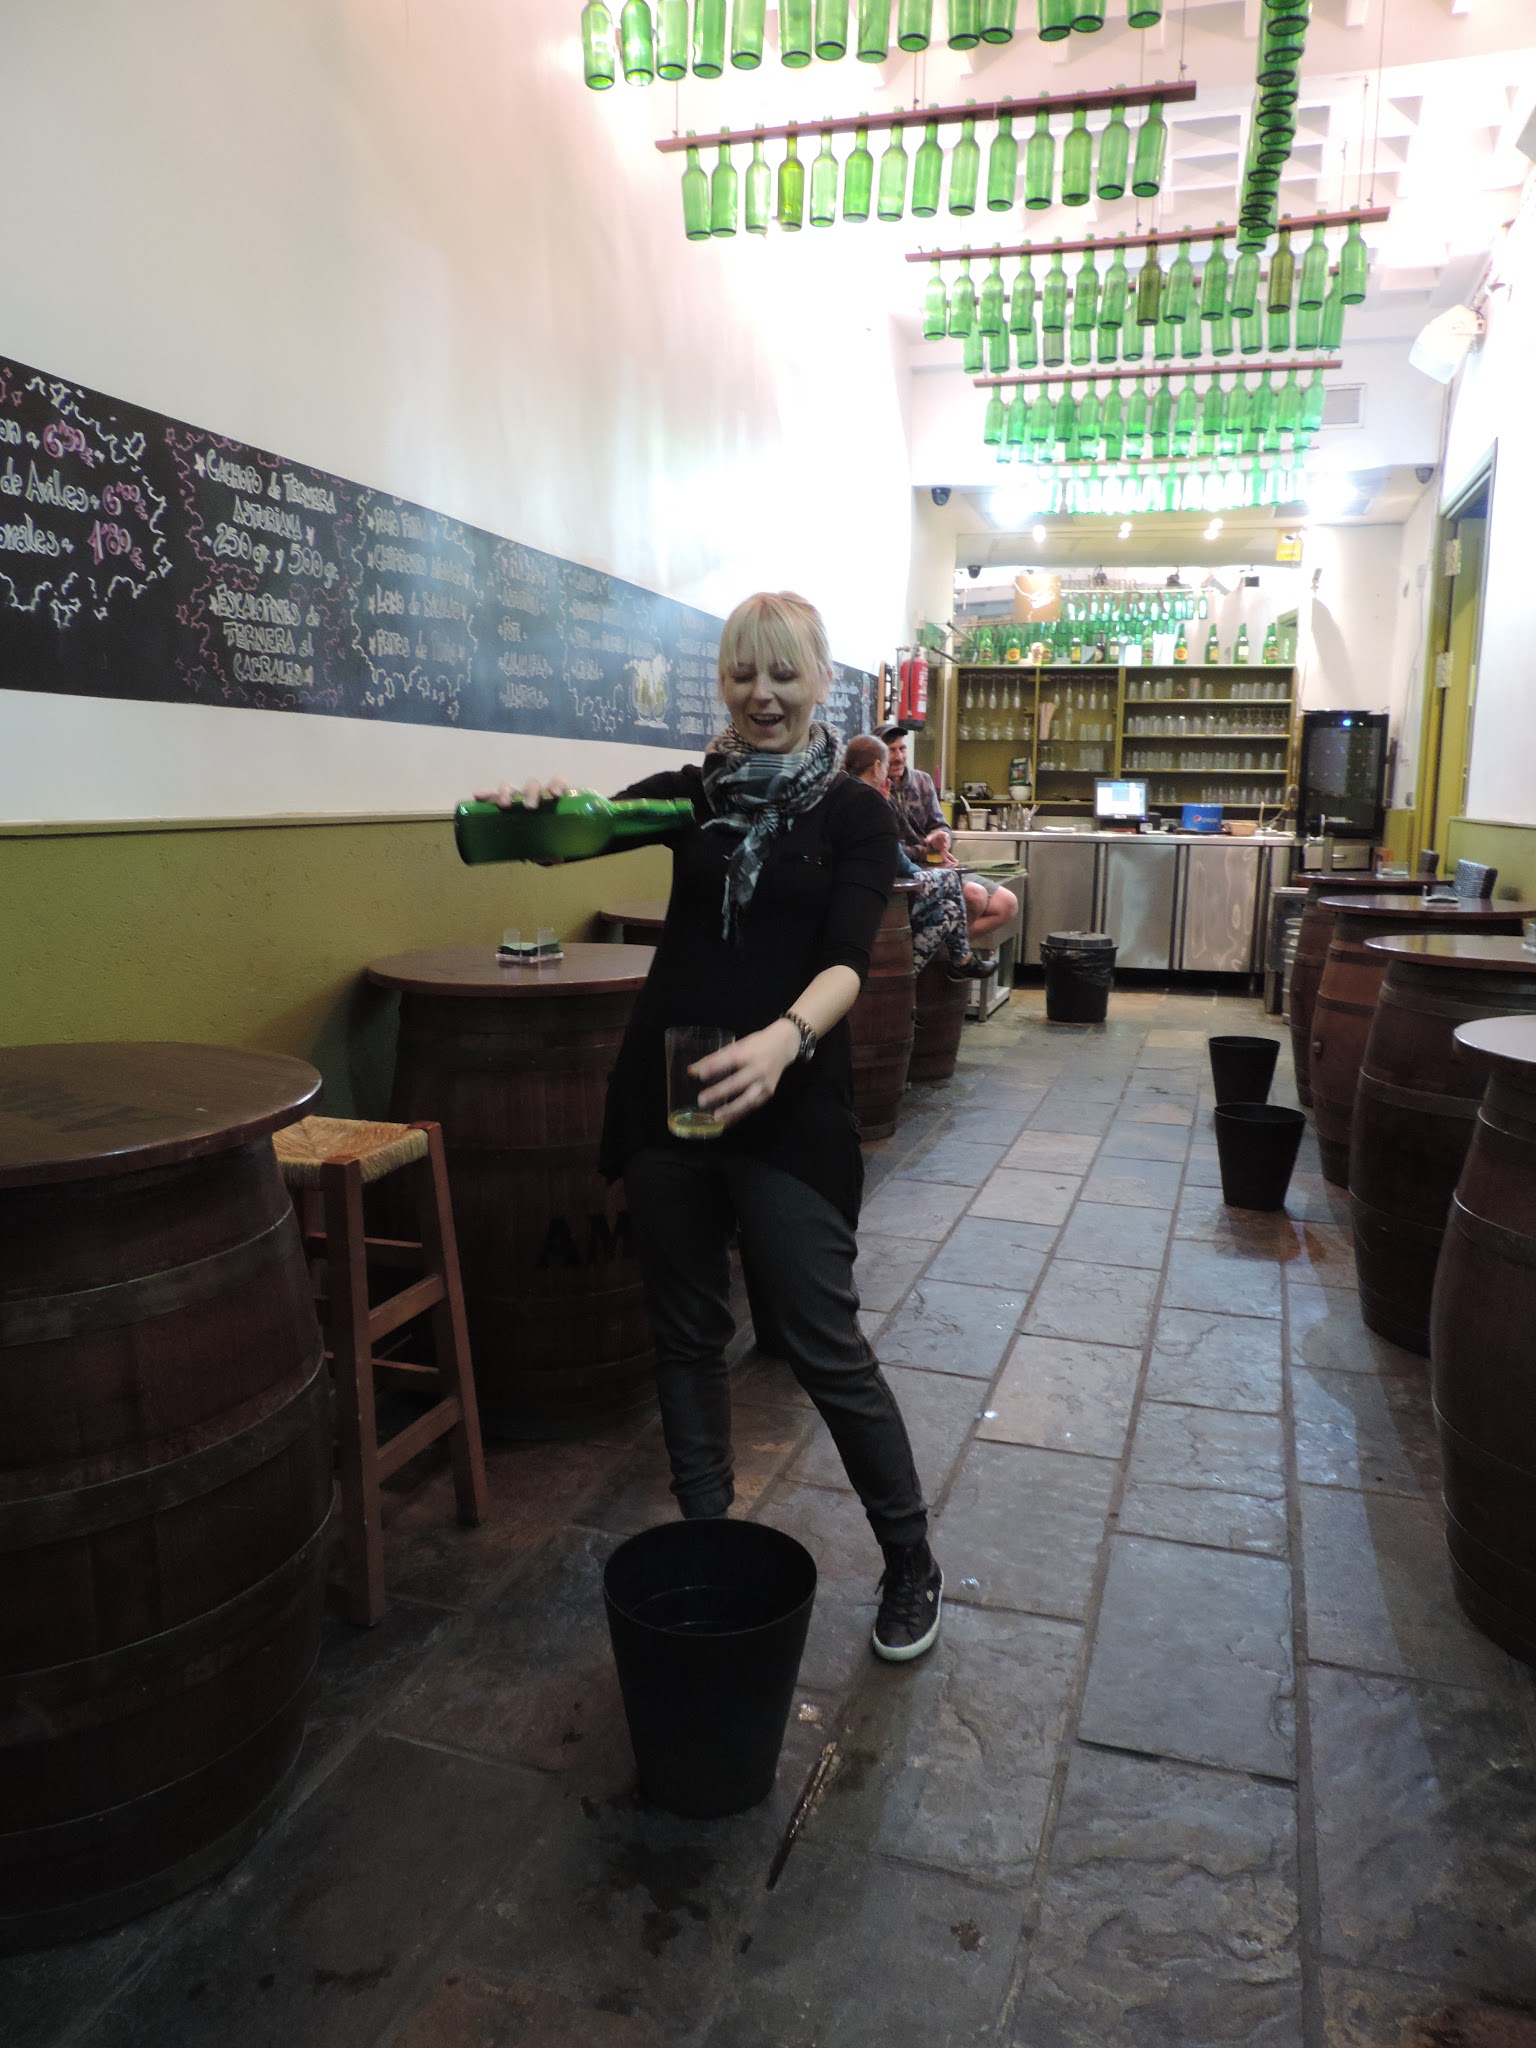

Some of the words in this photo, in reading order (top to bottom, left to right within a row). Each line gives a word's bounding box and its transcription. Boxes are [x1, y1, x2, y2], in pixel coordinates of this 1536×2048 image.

[0, 456, 23, 496] de
[267, 472, 281, 500] de
[213, 522, 252, 560] 250
[273, 548, 284, 574] y
[288, 543, 323, 578] 500
[223, 621, 296, 655] TERNERA
